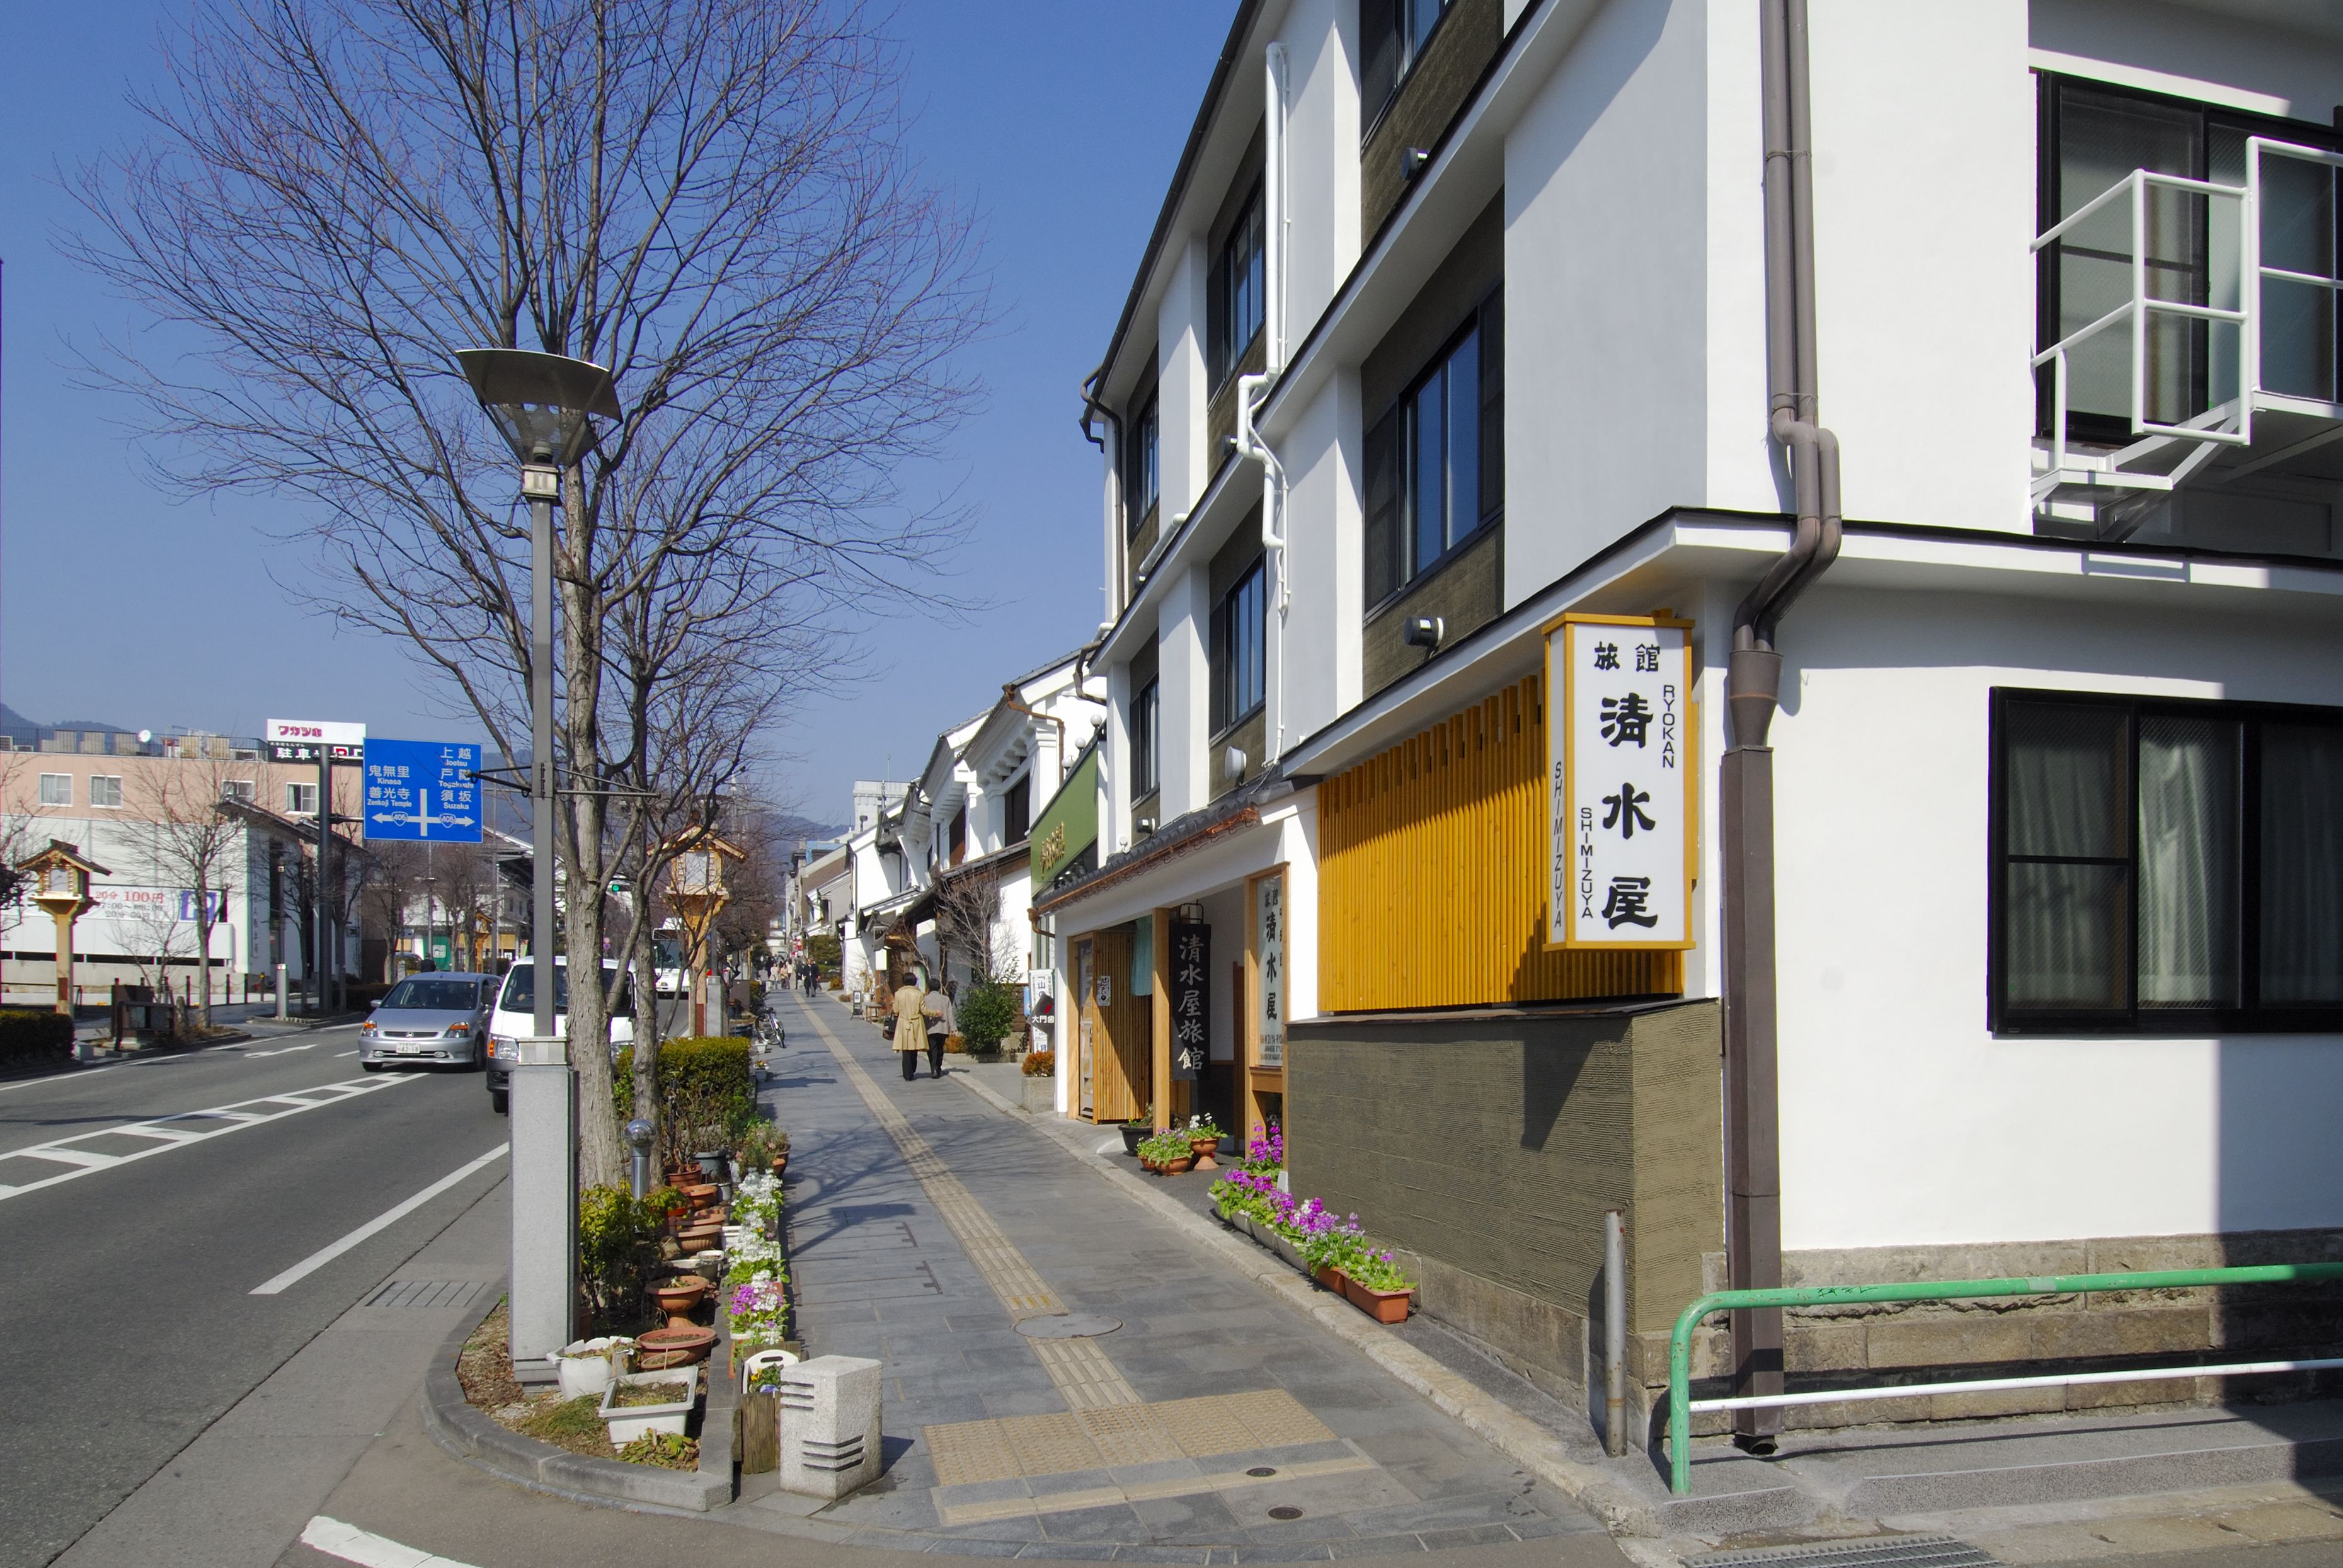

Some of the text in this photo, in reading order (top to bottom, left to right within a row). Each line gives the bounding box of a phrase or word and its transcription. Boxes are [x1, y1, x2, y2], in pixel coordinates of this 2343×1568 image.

[1594, 641, 1661, 672] 旅館
[1662, 684, 1675, 769] RYOKAN
[440, 747, 471, 760] 上越
[369, 765, 410, 778] 鬼無里
[367, 798, 412, 808] Zenkoji Temple
[369, 786, 410, 799] 善光寺
[441, 790, 472, 803] 須坂
[1600, 692, 1659, 930] 清水屋
[1554, 761, 1563, 929] SHIMIZUYA
[1580, 807, 1594, 919] SHIMIZUYA
[124, 891, 164, 903] 100円
[1266, 912, 1278, 1020] 清水屋
[1178, 934, 1205, 1070] 清水屋旅館
